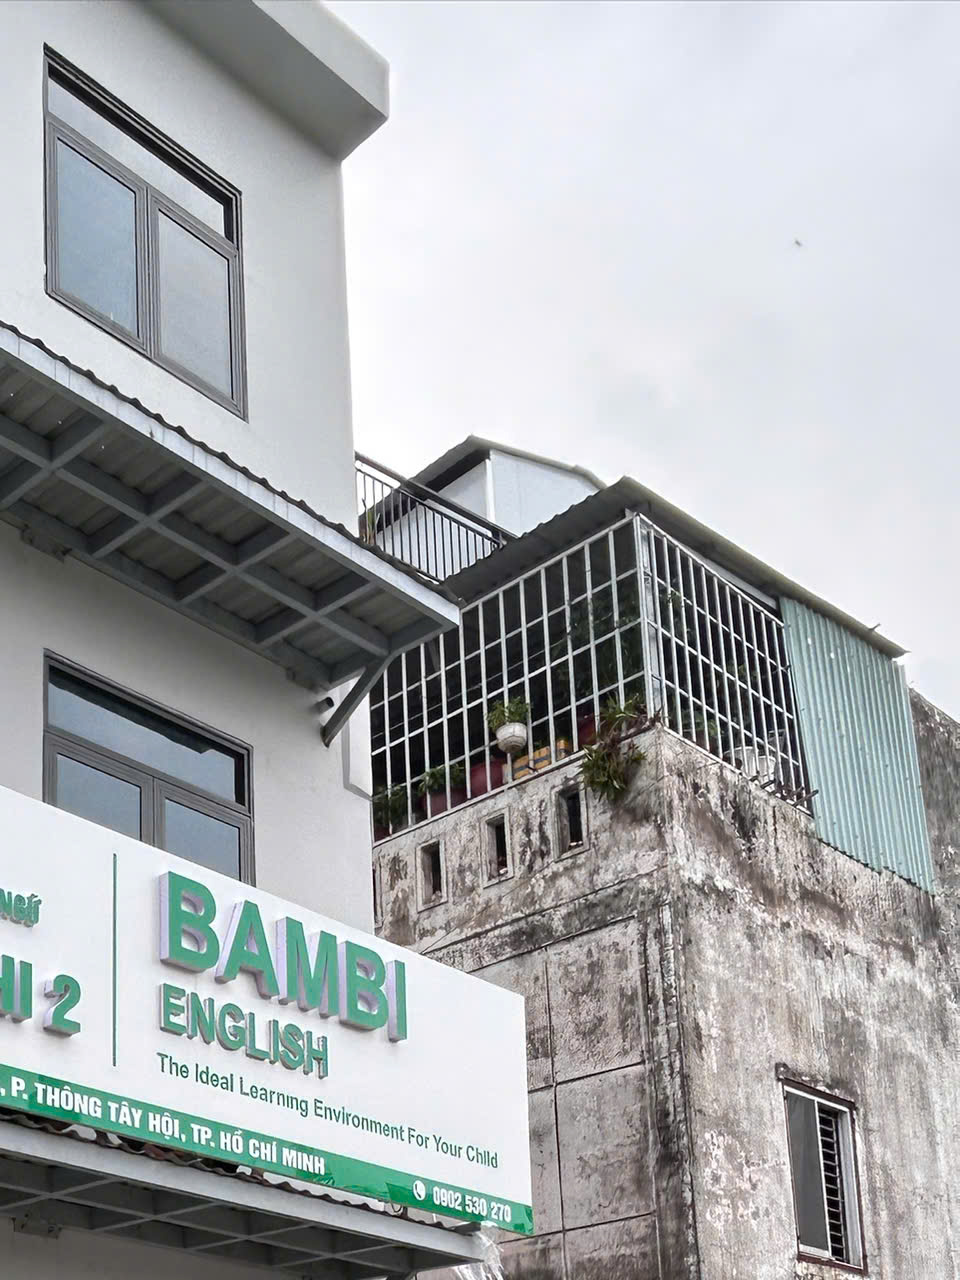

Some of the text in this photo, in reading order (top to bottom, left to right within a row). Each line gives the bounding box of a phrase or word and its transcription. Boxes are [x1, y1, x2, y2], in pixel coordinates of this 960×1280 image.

[159, 870, 408, 1043] BAMBI
[43, 974, 82, 1038] 2
[159, 982, 329, 1080] ENGLISH
[10, 1077, 29, 1099] P.
[34, 1082, 102, 1119] THÔNG
[107, 1101, 144, 1129] TÂY
[147, 1112, 186, 1143] HỘI,
[190, 1123, 215, 1148] TP.
[220, 1129, 244, 1154] HỒ
[248, 1139, 278, 1163] CHÍ
[282, 1151, 325, 1176] MINH
[156, 1052, 498, 1169] The Ideal Learning Environment For Your Child
[432, 1186, 512, 1223] 0902 530 270
